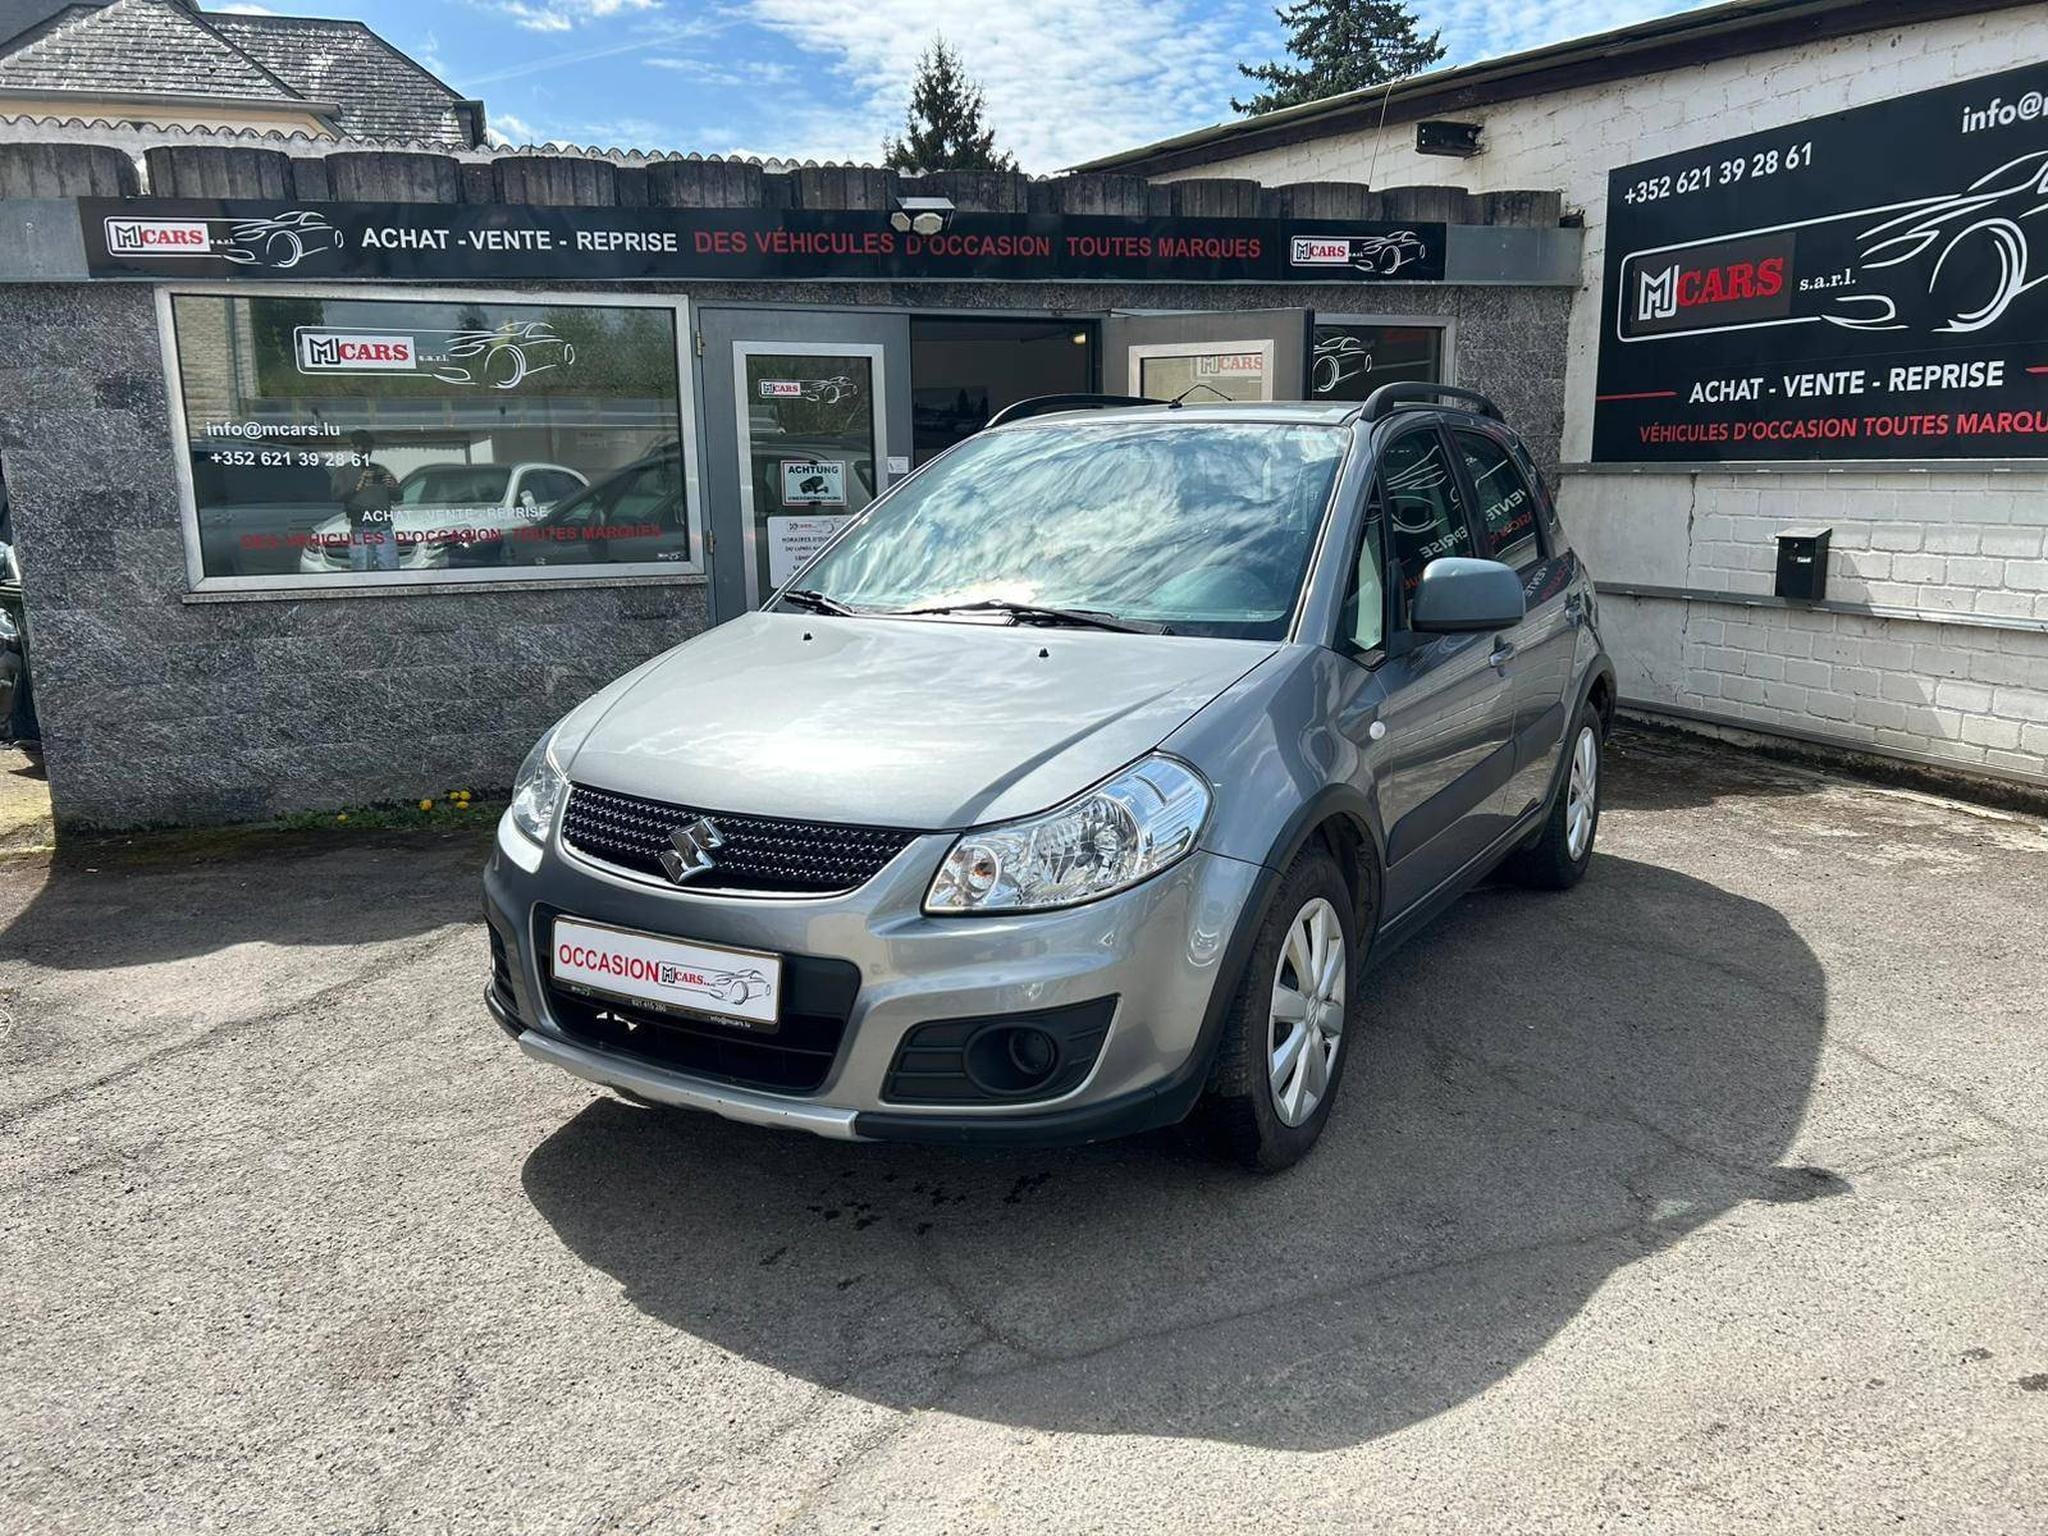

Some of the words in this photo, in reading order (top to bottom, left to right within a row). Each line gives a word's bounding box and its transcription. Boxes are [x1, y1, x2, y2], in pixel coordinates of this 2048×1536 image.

[1624, 175, 1671, 204] +352
[1676, 165, 1711, 194] 621
[1719, 158, 1745, 184] 39
[1751, 150, 1779, 178] 28
[1785, 142, 1812, 170] 61
[361, 227, 450, 249] ACHAT
[576, 231, 678, 252] REPRISE
[694, 231, 747, 253] DES
[754, 226, 895, 254] VÉHICULES
[906, 234, 1051, 257] D'OCCASION
[1067, 236, 1151, 258] TOUTES
[1158, 237, 1261, 259] MARQUES
[1799, 268, 1857, 291] s.a.r.l.
[1689, 376, 1763, 404] ACHAT
[1783, 370, 1865, 399] VENTE
[1888, 360, 2005, 392] REPRISE
[206, 422, 341, 439] info@mcars.lu
[1639, 422, 1728, 443] VÉHICULES
[1733, 418, 1857, 441] D'OCCASION
[1863, 414, 1949, 438] TOUTES
[1955, 410, 2048, 434] MARQU
[210, 452, 256, 466] +352
[261, 452, 291, 466] 621
[299, 453, 319, 467] 39
[325, 454, 345, 467] 28
[351, 453, 371, 468] 61
[788, 465, 839, 474] ACHTUNG
[361, 510, 414, 522] ACHAT
[487, 505, 549, 520] REPRISE
[559, 944, 660, 983] OCCASION
